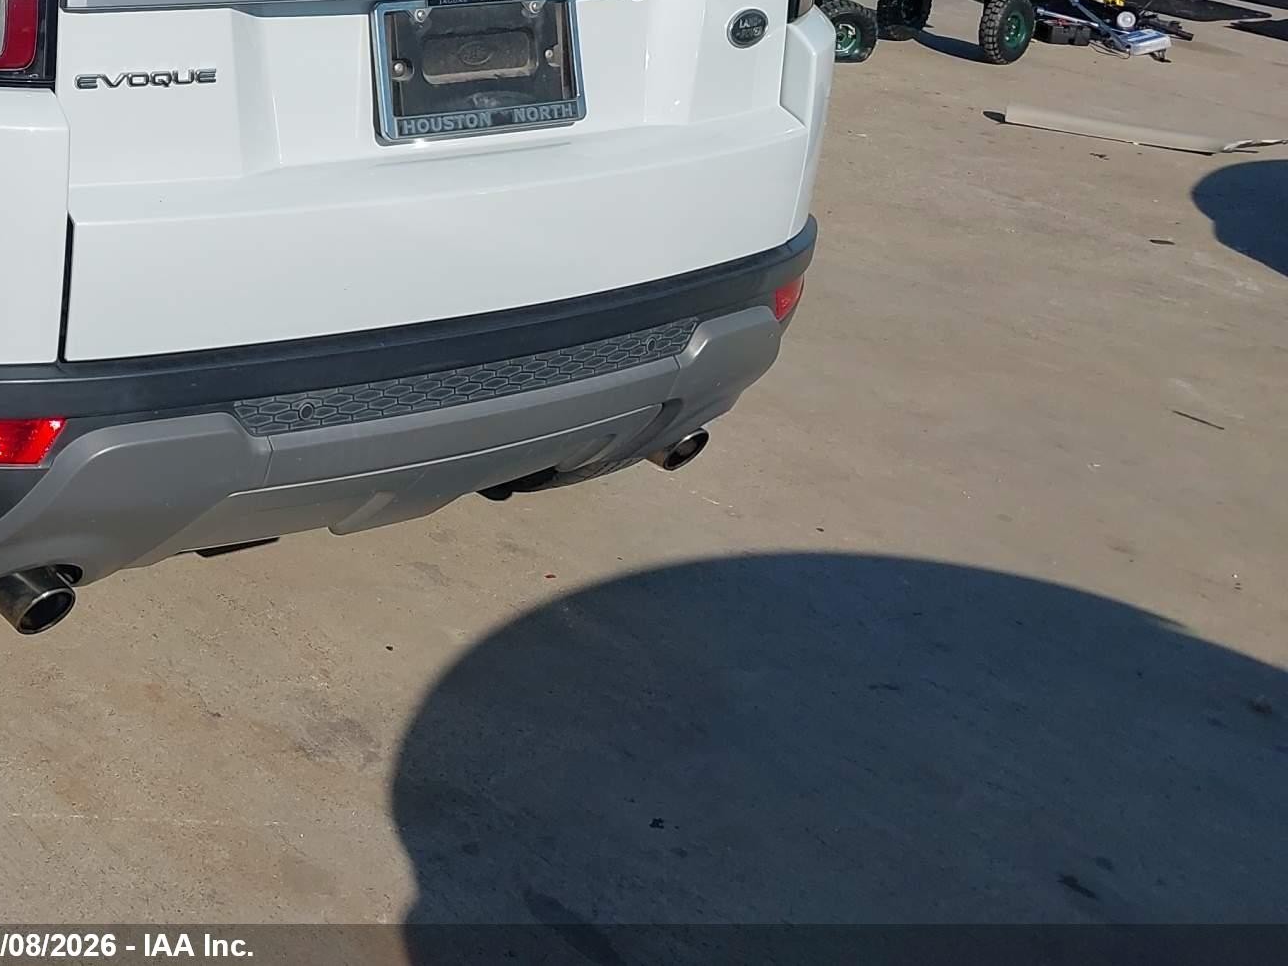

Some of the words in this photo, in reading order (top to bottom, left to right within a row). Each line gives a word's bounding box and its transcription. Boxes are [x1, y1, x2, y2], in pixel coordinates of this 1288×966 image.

[75, 68, 217, 89] EVOQUE
[403, 112, 492, 134] HOUSTON
[514, 103, 573, 122] NORTH
